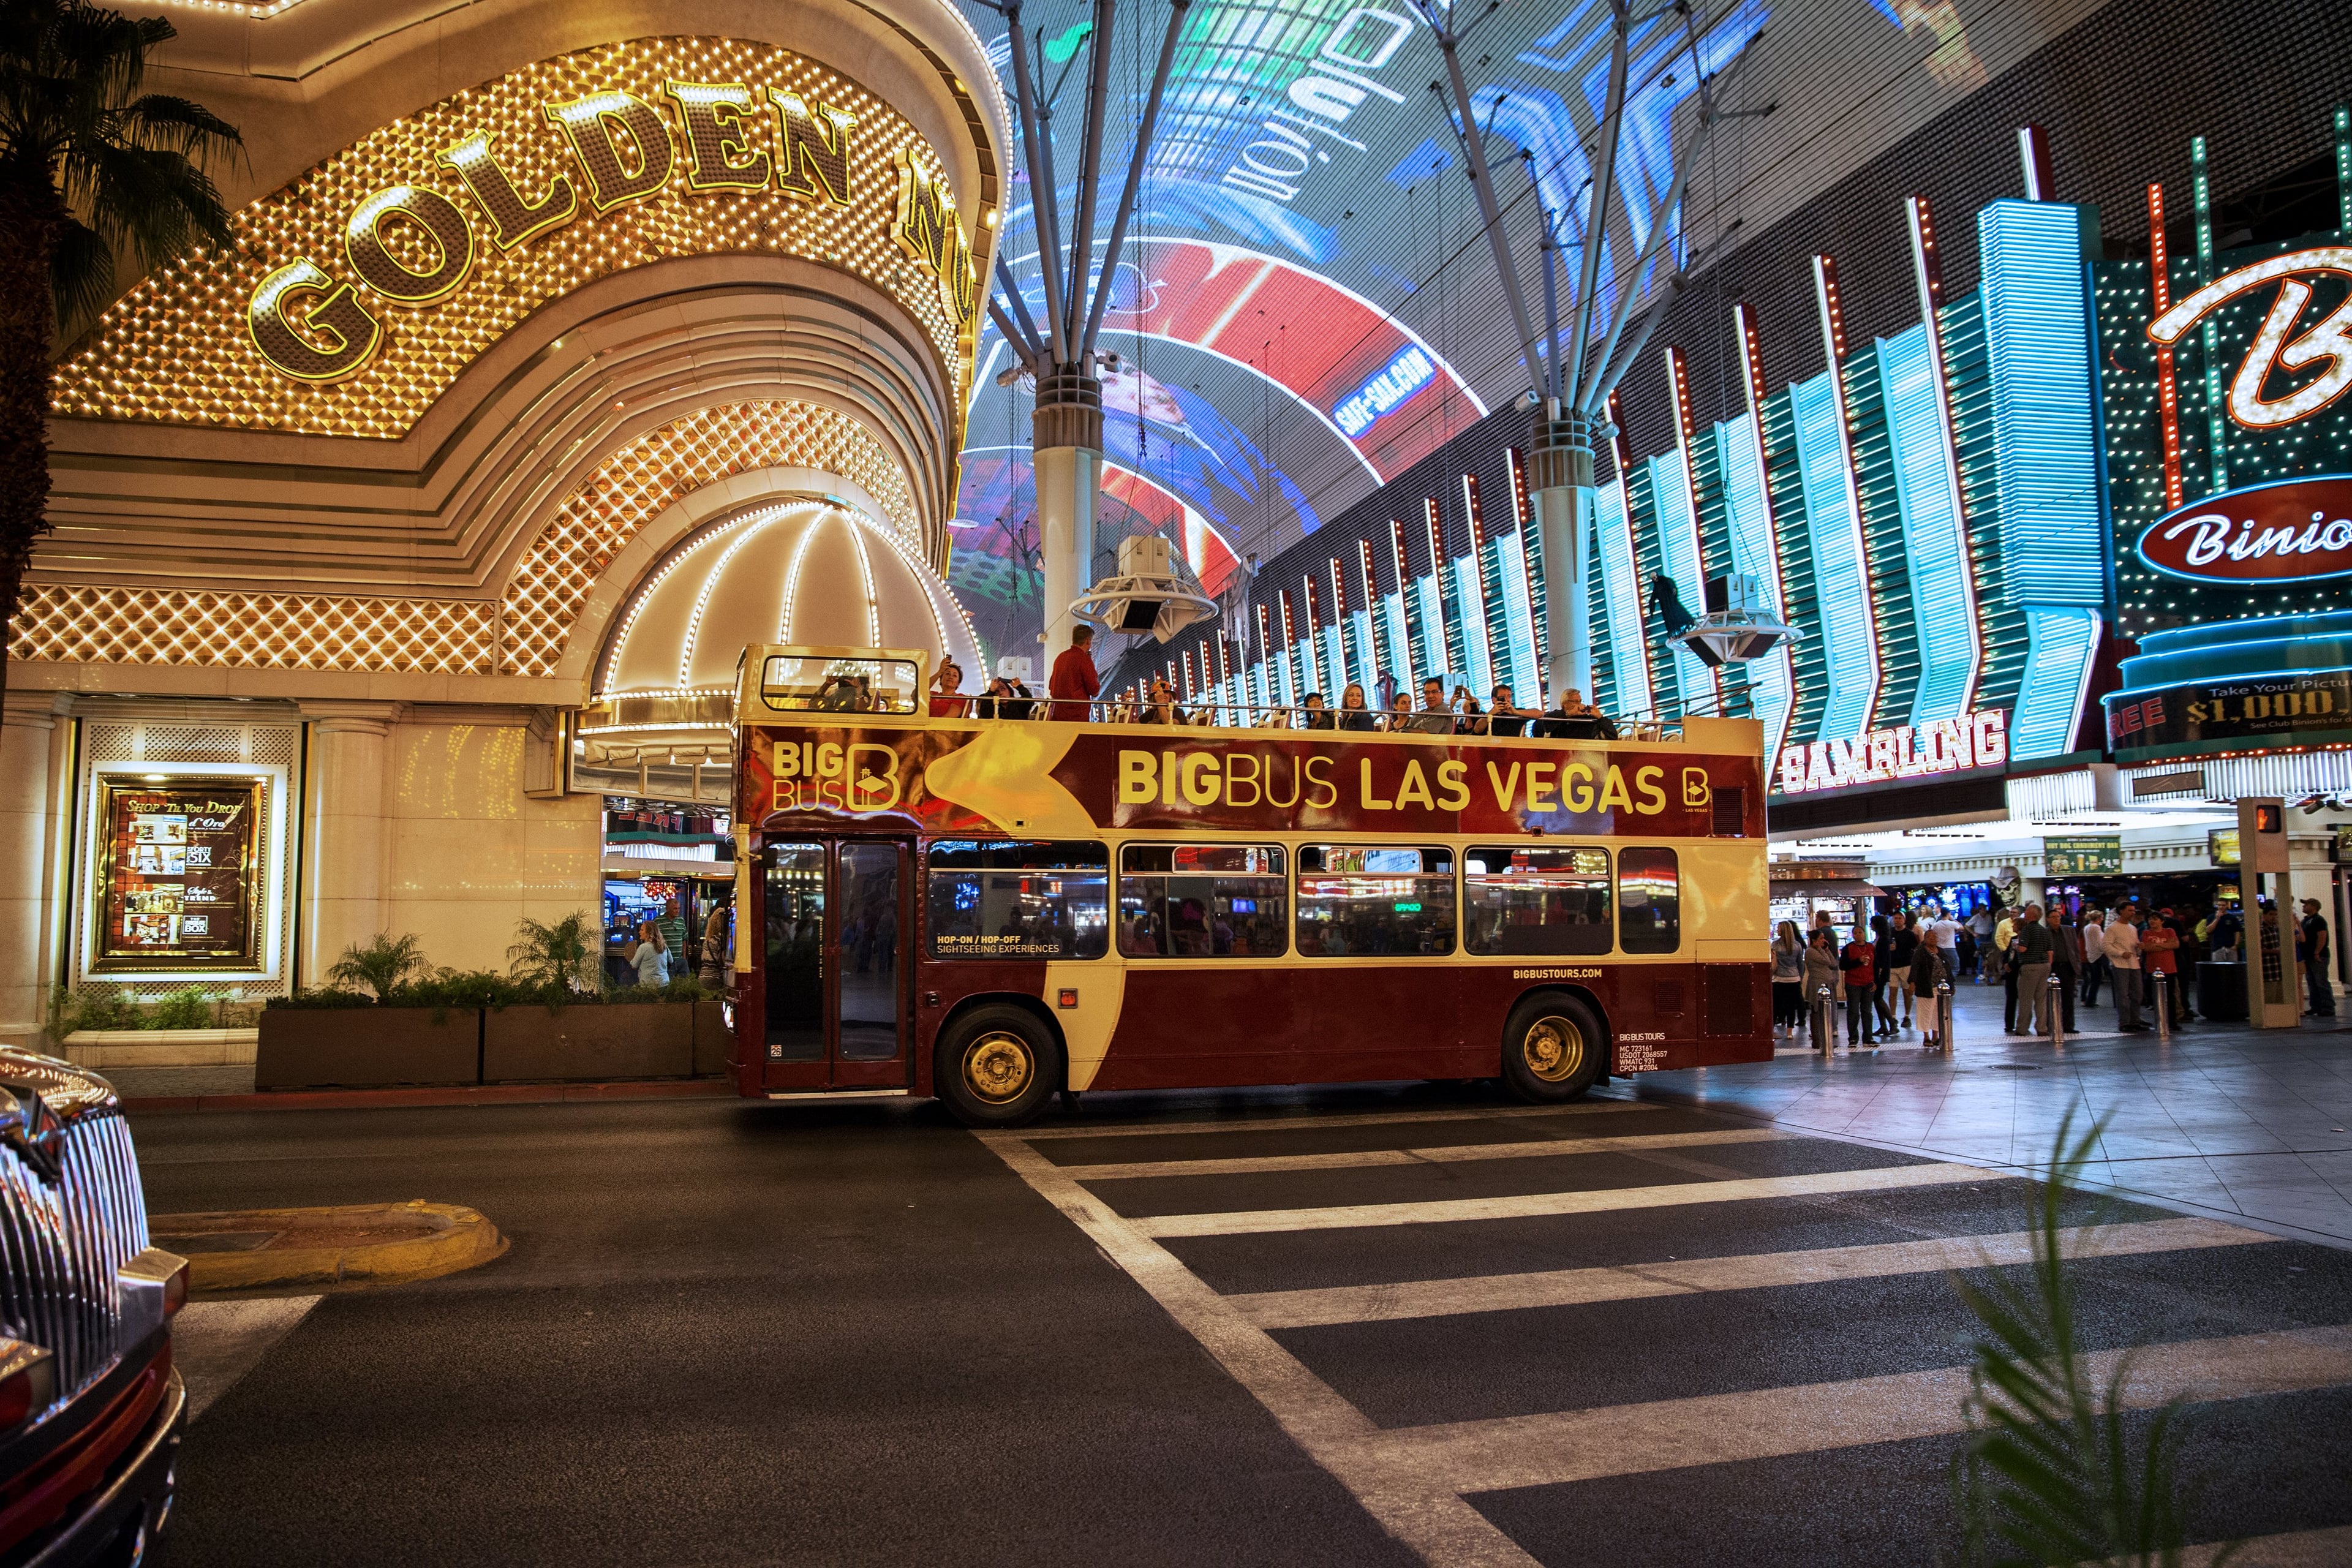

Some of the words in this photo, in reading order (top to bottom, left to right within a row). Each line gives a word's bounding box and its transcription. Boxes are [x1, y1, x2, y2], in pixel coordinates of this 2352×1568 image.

[248, 78, 857, 384] GOLDEN
[900, 149, 977, 323] NU
[2209, 687, 2250, 698] Take
[2254, 682, 2296, 693] Your
[2301, 679, 2352, 689] Pictu
[2108, 696, 2166, 742] REE
[774, 742, 843, 777] BIG
[1782, 708, 2006, 794] GAMBLING
[773, 780, 843, 811] BUS
[1360, 758, 1470, 813] LAS
[1487, 761, 1666, 815] VEGAS
[127, 800, 159, 813] SHOP
[190, 852, 212, 862] SIX
[975, 935, 979, 944] /
[1513, 969, 1602, 979] BIGBUSTOURS.COM
